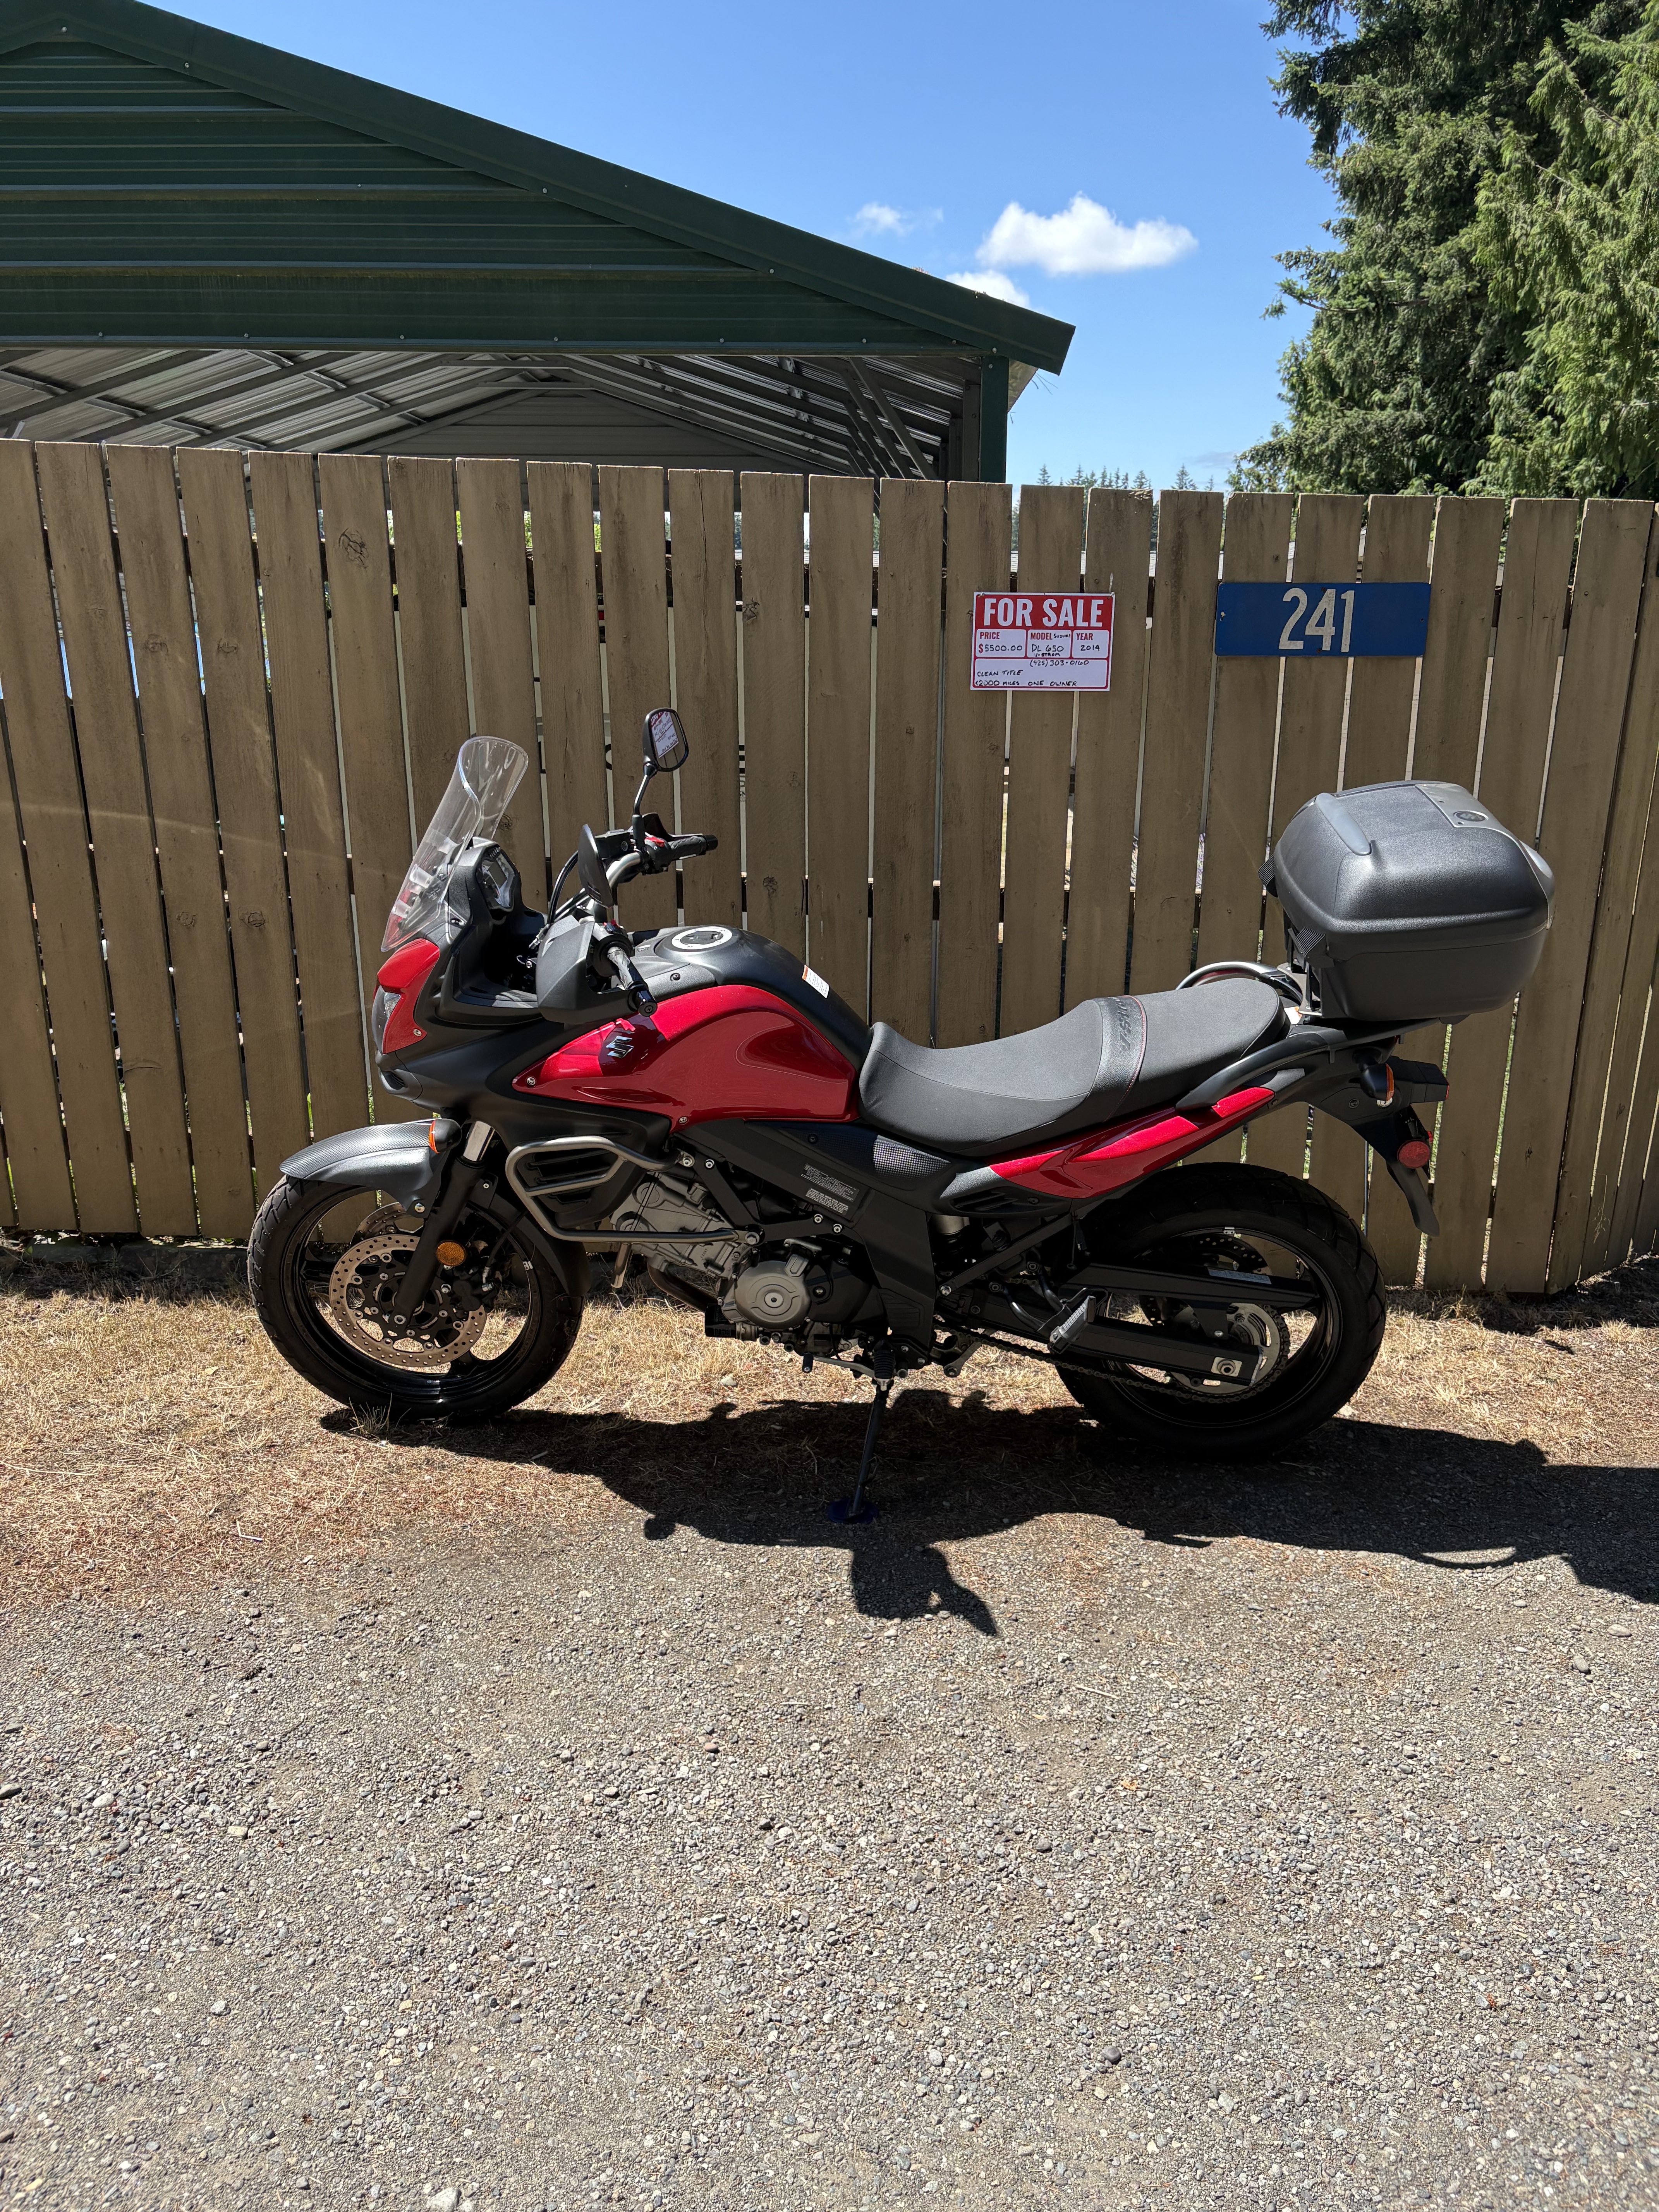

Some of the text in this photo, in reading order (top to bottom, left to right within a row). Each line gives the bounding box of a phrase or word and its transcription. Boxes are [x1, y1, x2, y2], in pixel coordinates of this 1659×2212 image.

[984, 598, 1104, 627] FOR SALE
[1279, 587, 1355, 652] 241
[979, 632, 1000, 640] PRICE
[1032, 644, 1042, 652] DL
